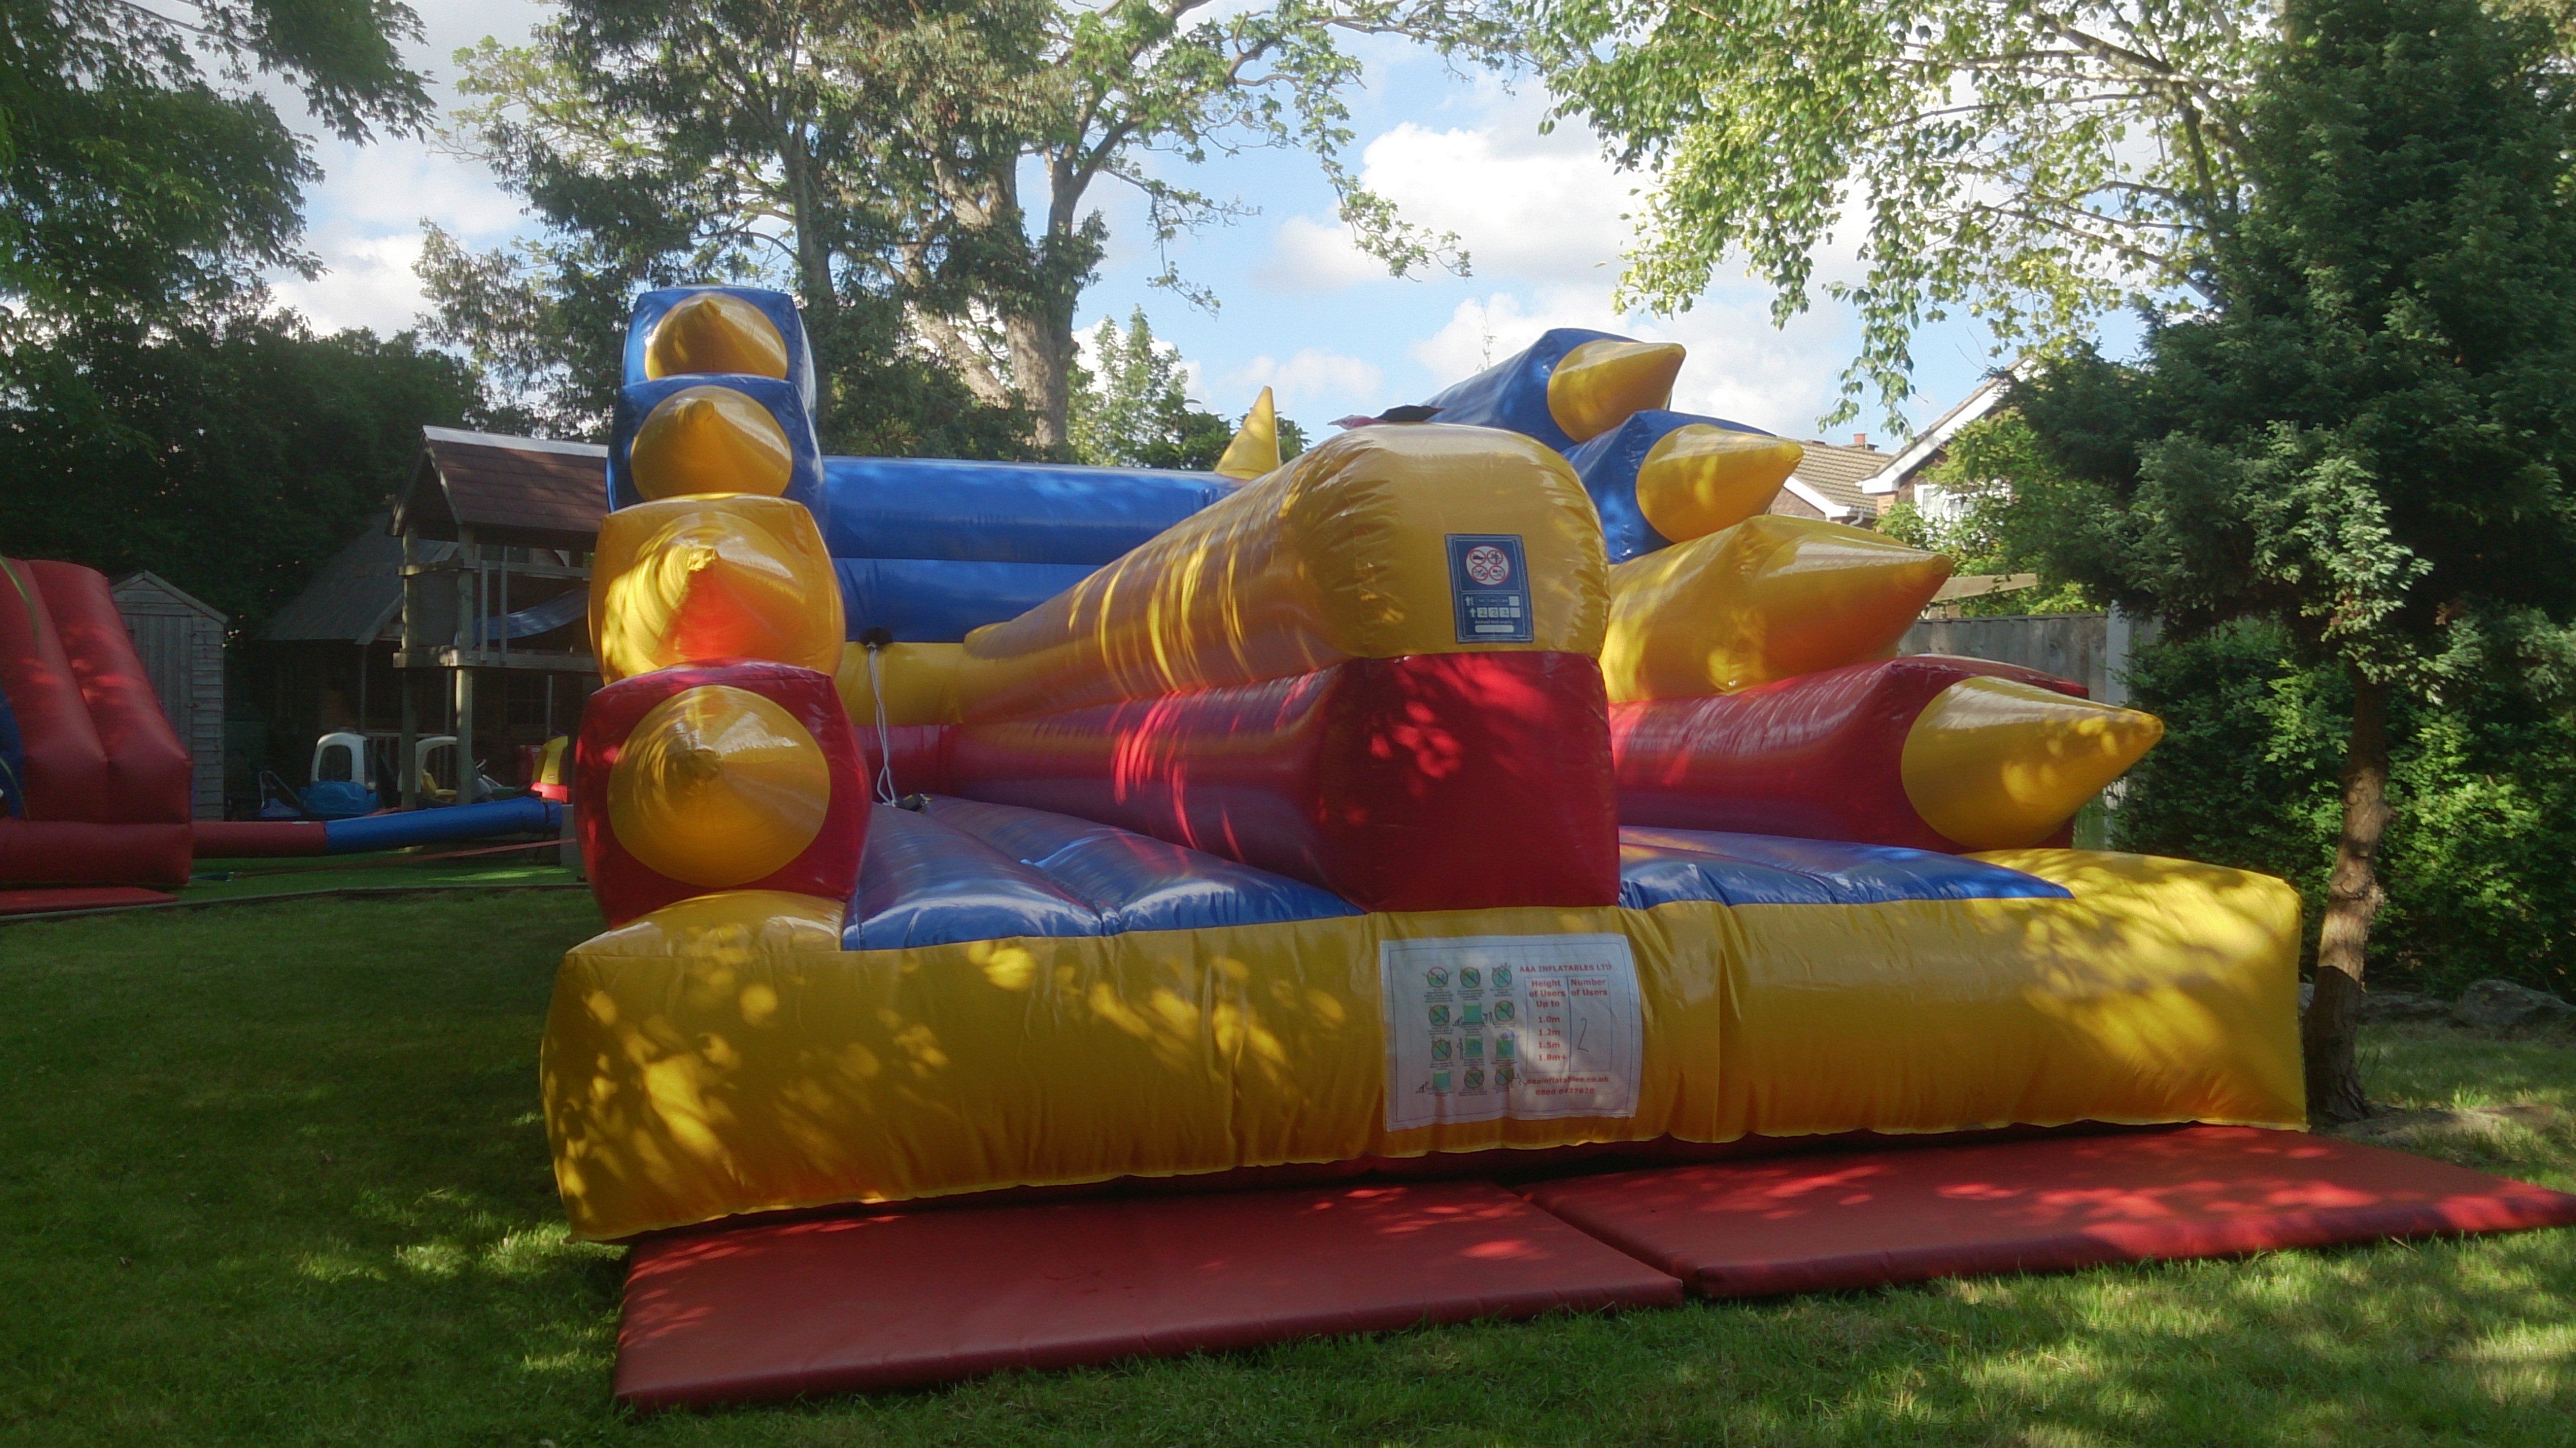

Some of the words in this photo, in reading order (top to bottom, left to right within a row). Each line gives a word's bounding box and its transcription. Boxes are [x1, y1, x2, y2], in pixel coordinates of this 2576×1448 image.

[1538, 964, 1594, 972] INFLATABLES
[1531, 980, 1561, 988] Height
[1578, 1018, 1590, 1052] 2
